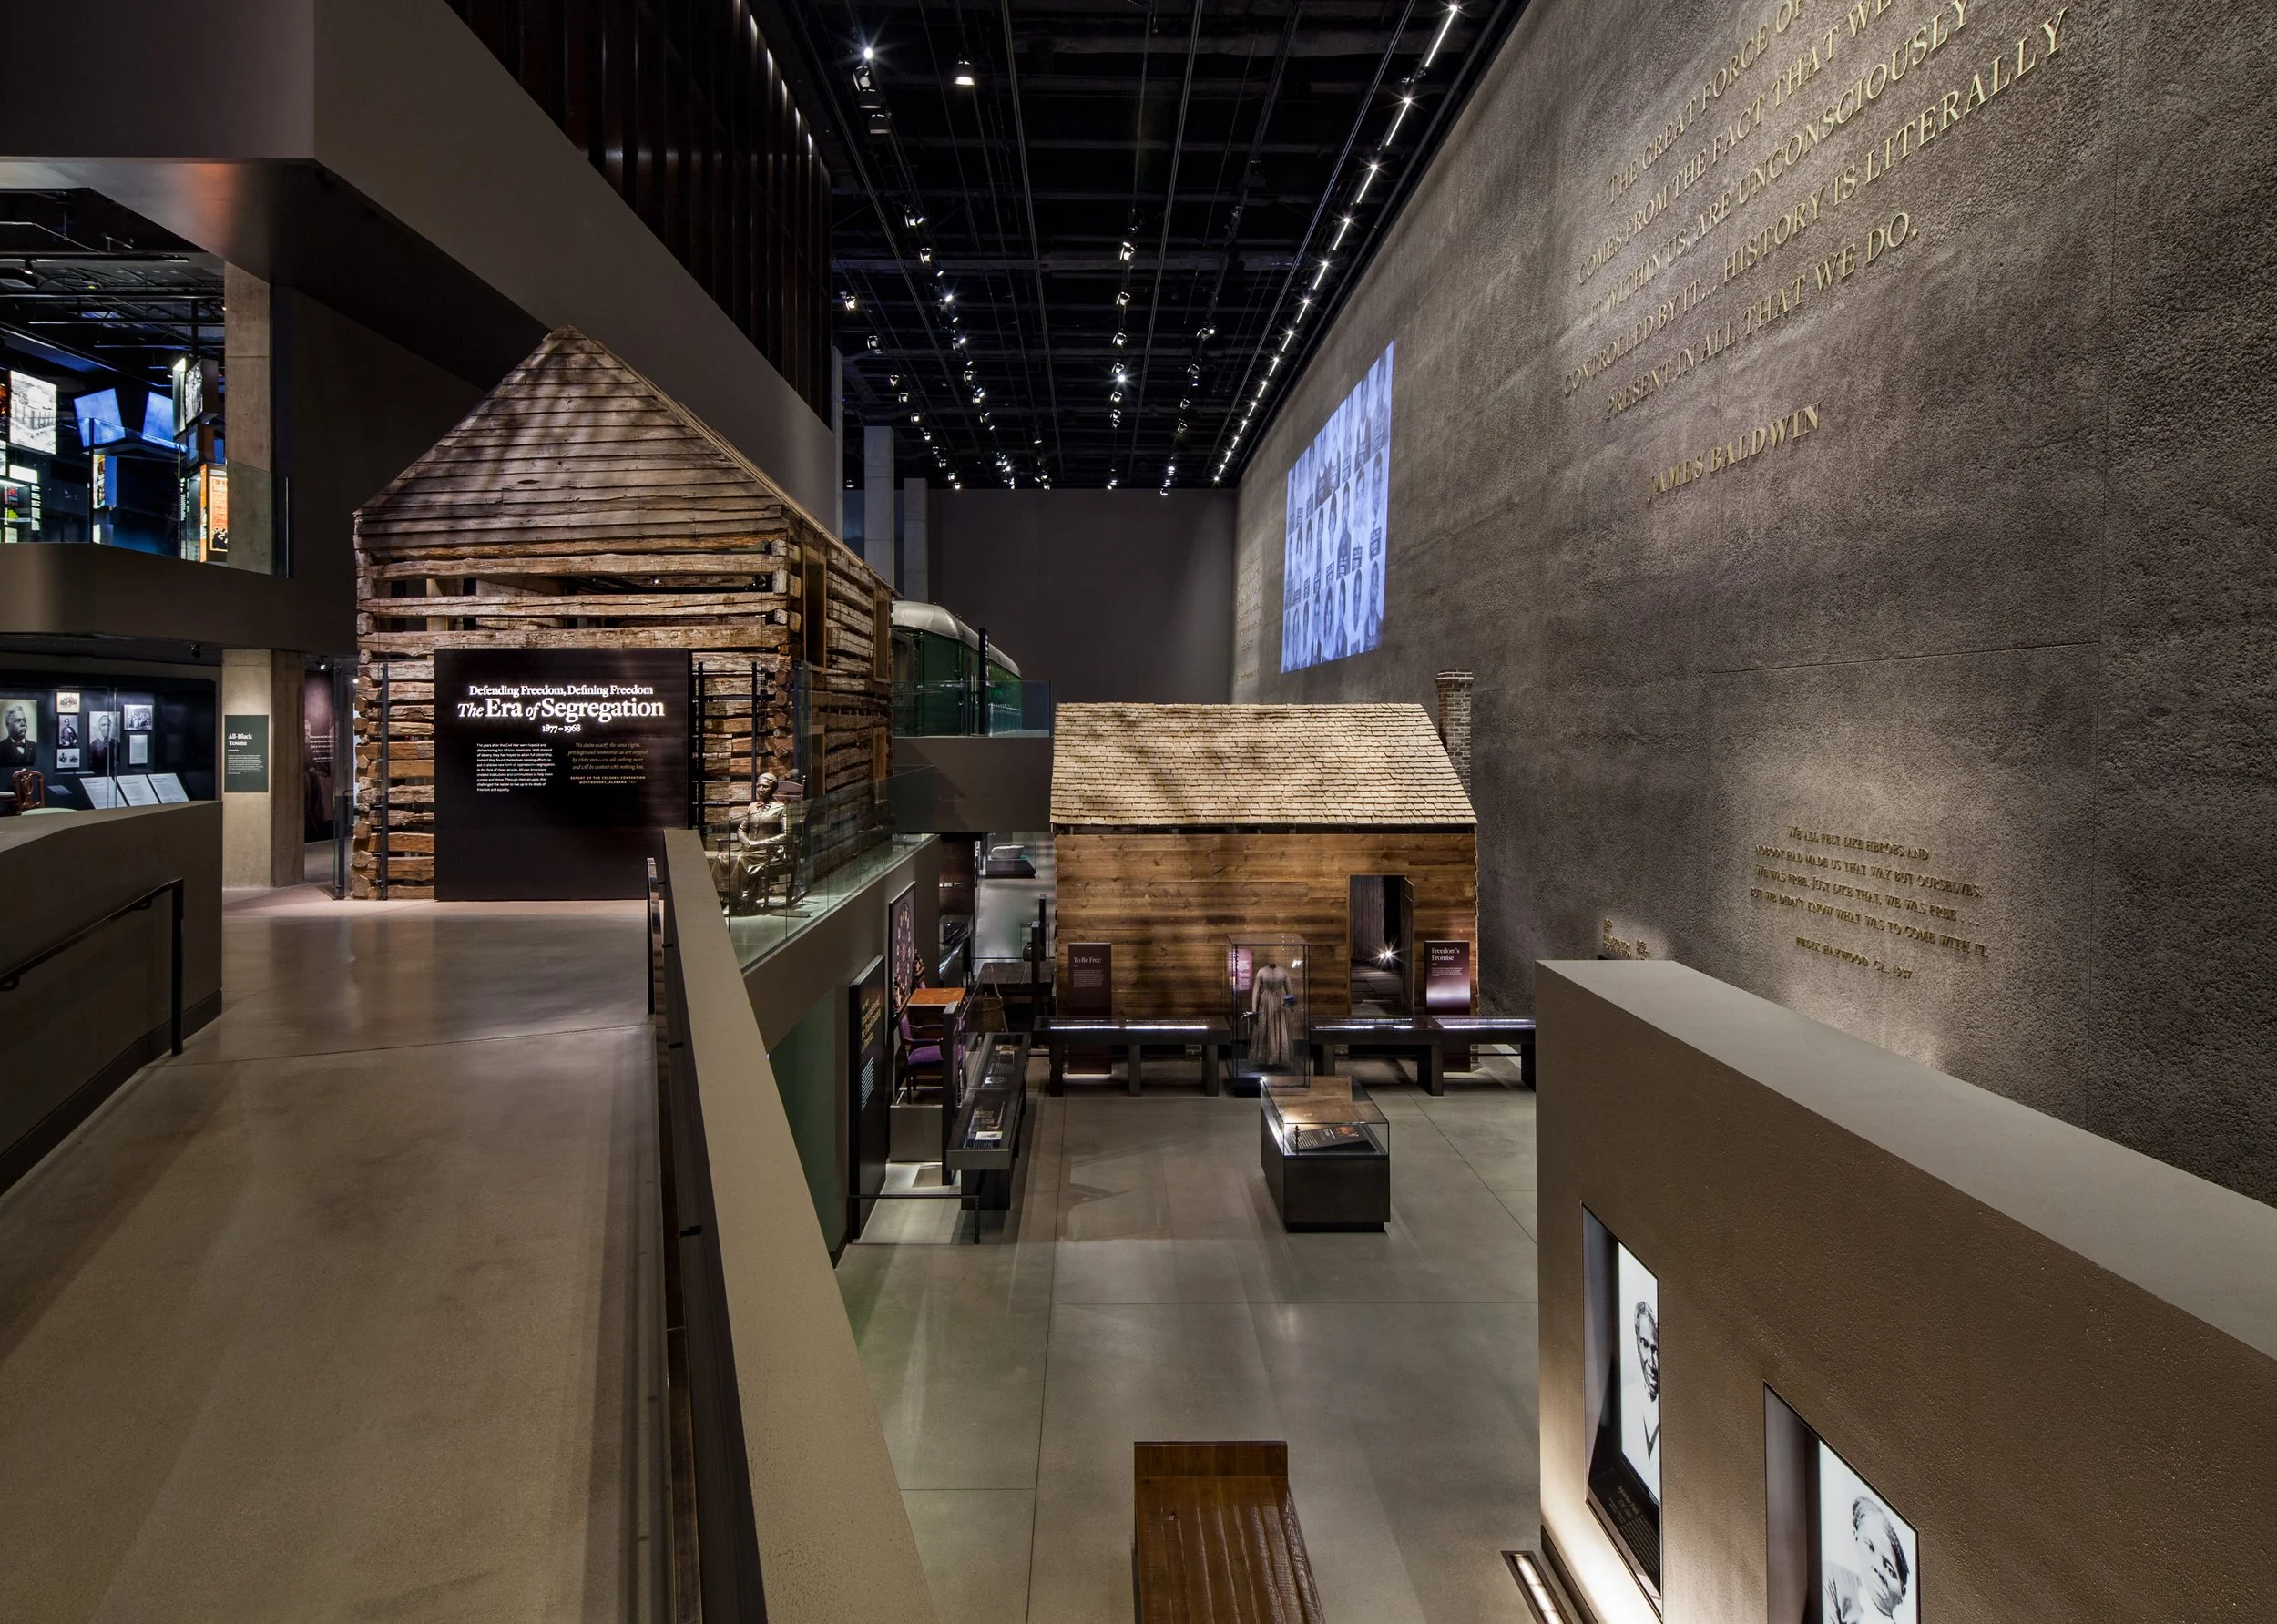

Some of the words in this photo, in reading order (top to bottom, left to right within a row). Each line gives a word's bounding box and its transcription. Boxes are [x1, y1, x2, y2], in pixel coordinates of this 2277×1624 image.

[1608, 158, 1639, 203] THE
[1642, 97, 1697, 169] GREAT
[1701, 23, 1769, 113] FORCE
[1579, 229, 1622, 284] COMES
[1626, 186, 1669, 242] FROM
[1673, 148, 1707, 199] THE
[1712, 95, 1766, 164] FACT
[1772, 26, 1839, 108] THAT
[1591, 301, 1602, 325] IT
[1608, 249, 1664, 311] WITHIN
[1668, 229, 1691, 262] US,
[1696, 190, 1731, 241] ARE
[1738, 0, 1968, 204] UNCONSCIOUSLY
[1565, 315, 1653, 395] CONTROLLED
[1658, 294, 1679, 330] BY
[1724, 187, 1825, 283] HISTORY
[1833, 163, 1856, 209] IS
[1865, 7, 2068, 184] LITERALLY
[1607, 359, 1671, 420] PRESENT
[1677, 342, 1697, 376] IN
[1701, 321, 1736, 363] ALL
[1744, 273, 1805, 335] THAT
[1814, 243, 1856, 291] WE
[1866, 212, 1918, 263] DO.
[1648, 455, 1703, 503] JAMES
[1710, 401, 1822, 473] BALDWIN
[457, 702, 484, 717] The
[485, 698, 523, 717] Era
[526, 702, 541, 720] of
[541, 697, 665, 722] Segregation
[469, 685, 519, 698] Defending
[521, 685, 566, 696] Freedom,
[567, 685, 608, 698] Defining
[610, 685, 653, 694] Freedom
[1831, 860, 1841, 870] US
[1844, 862, 1866, 875] THAT
[1894, 871, 1913, 884] BUT
[1844, 837, 1863, 850] LIKE
[1907, 847, 1929, 860] AND
[1833, 883, 1853, 897] LIKE
[1836, 908, 1862, 924] WHAT
[1887, 921, 1902, 935] TO
[1904, 925, 1935, 944] COME
